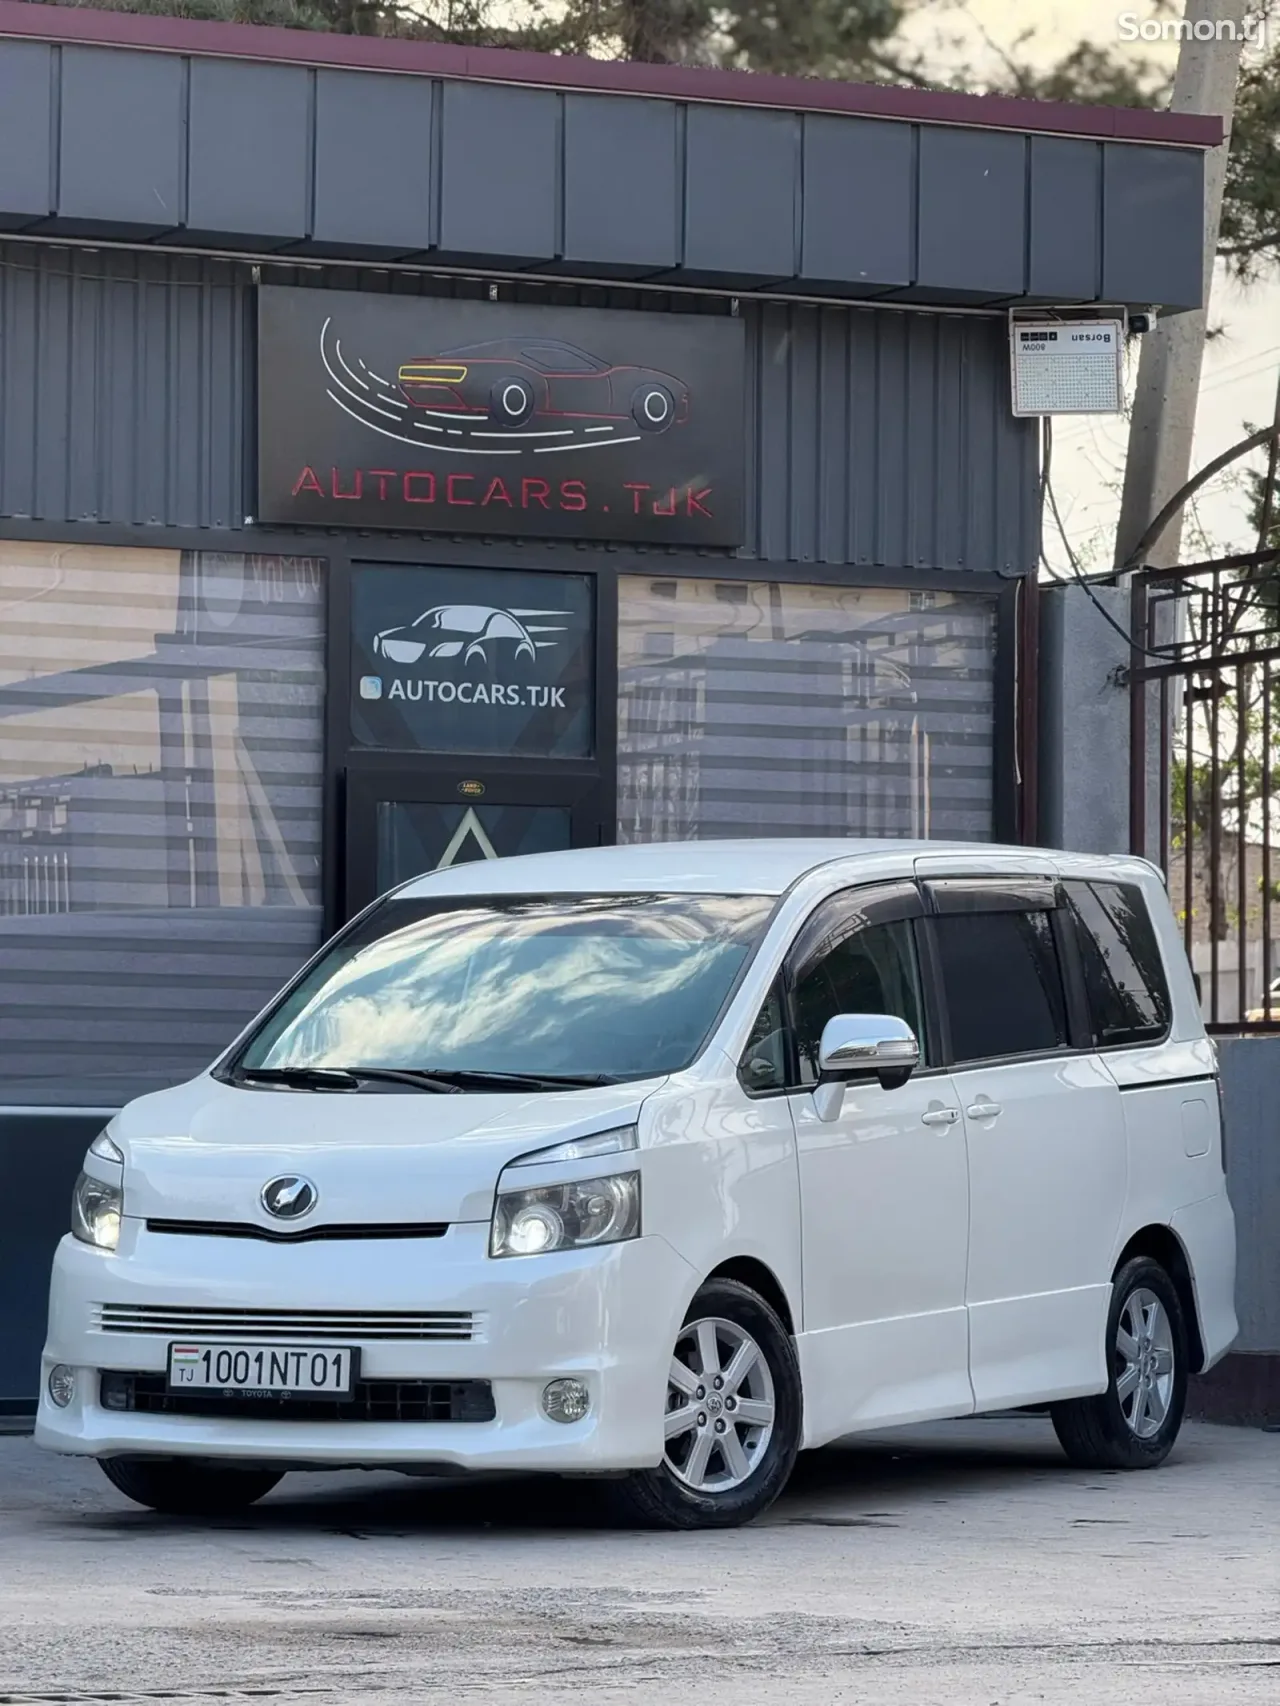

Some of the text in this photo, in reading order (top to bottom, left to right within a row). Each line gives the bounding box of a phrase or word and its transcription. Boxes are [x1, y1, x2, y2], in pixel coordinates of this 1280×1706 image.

[1071, 333, 1111, 343] Borsan
[388, 679, 566, 708] AUTOCARS.TJK
[179, 1349, 342, 1387] TJ 1001NT01
[242, 1389, 273, 1398] TOYOTA
